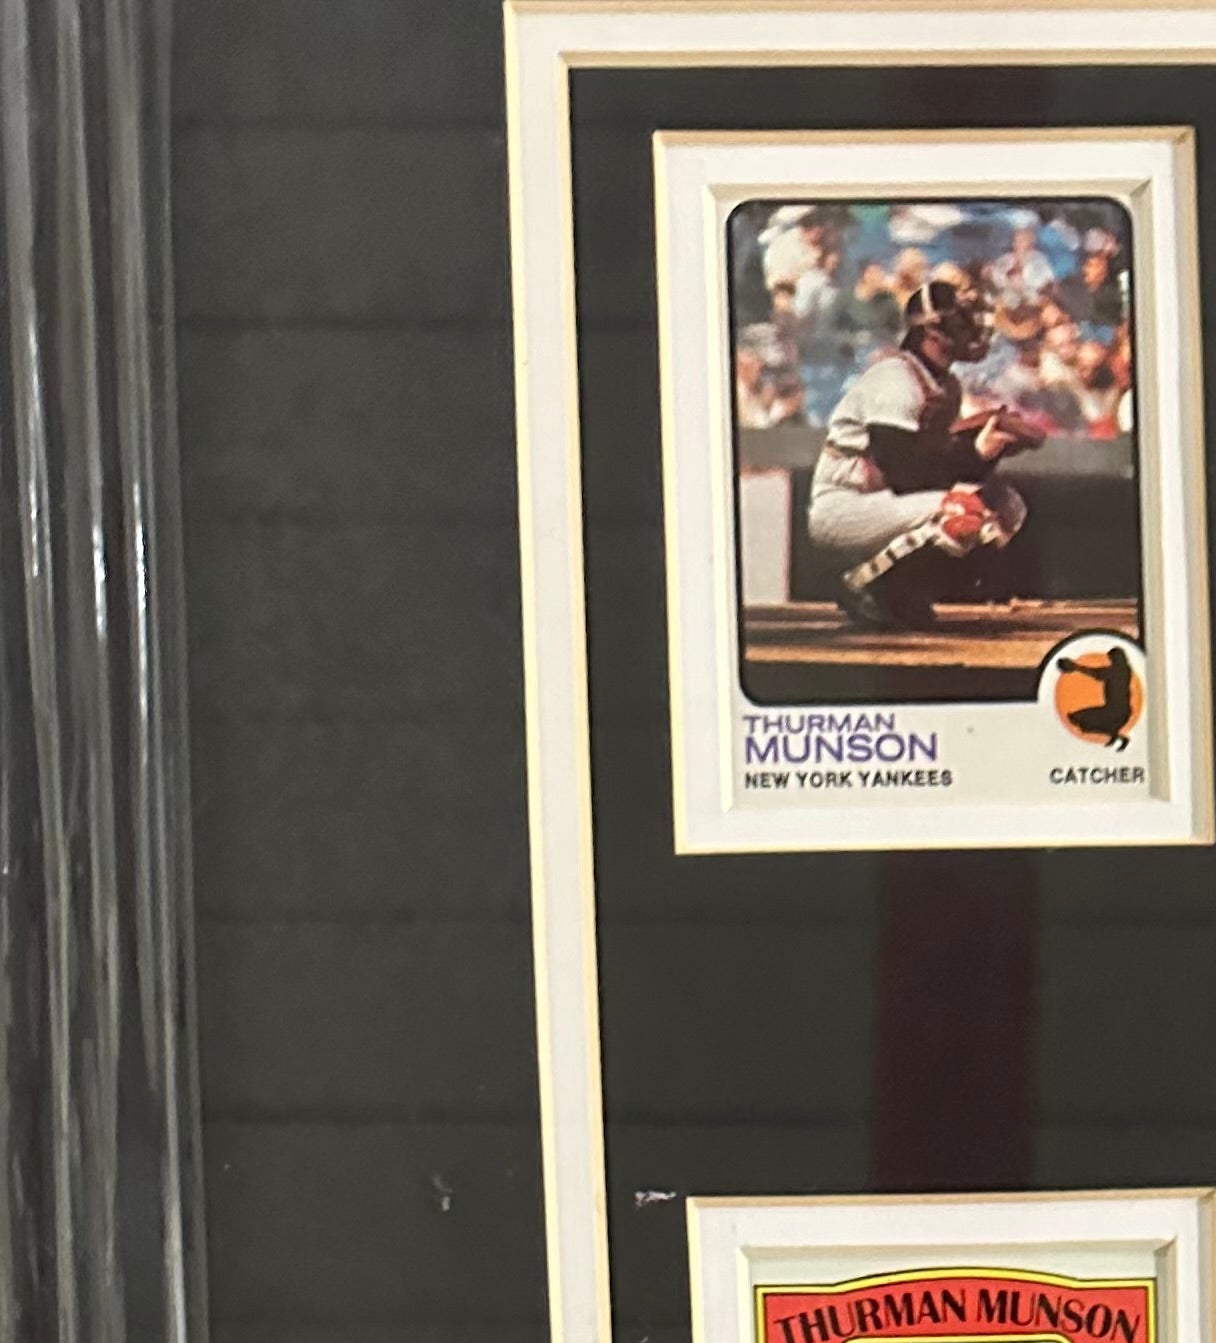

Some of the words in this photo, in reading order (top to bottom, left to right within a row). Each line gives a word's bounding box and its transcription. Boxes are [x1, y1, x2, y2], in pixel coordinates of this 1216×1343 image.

[742, 713, 896, 734] THURMAN
[745, 733, 937, 764] MUNSON
[745, 771, 790, 789] NEW
[796, 770, 852, 788] YORK
[859, 769, 953, 787] YANKEES
[1049, 766, 1145, 785] CATCHER
